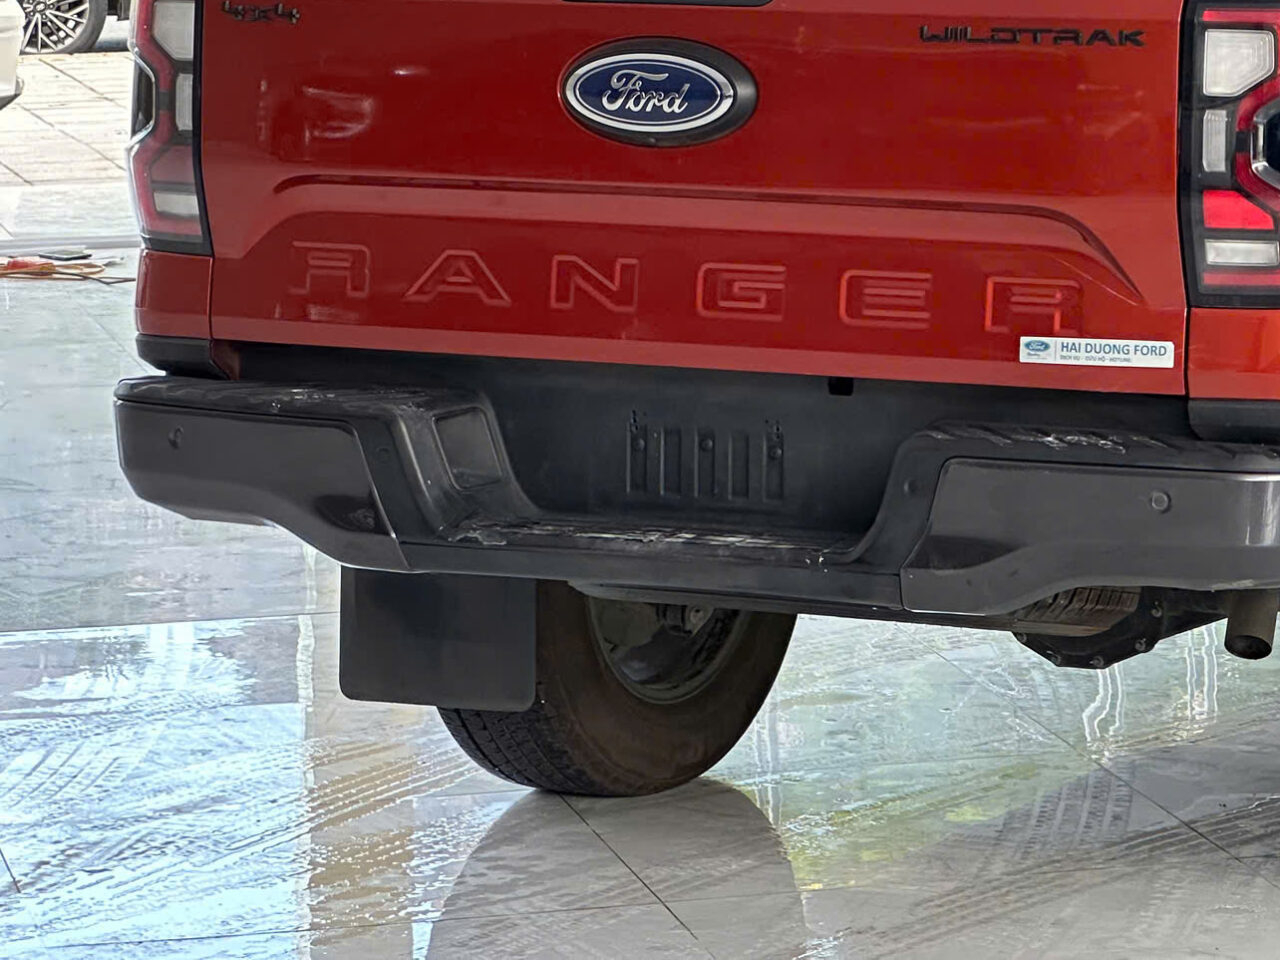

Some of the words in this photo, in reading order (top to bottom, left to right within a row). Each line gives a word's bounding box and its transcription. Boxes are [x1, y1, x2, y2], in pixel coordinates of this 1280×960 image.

[920, 24, 1146, 48] WILDTRAK
[601, 69, 692, 114] Ford
[290, 240, 1085, 336] RANGER
[1061, 342, 1082, 353] HAI
[1084, 343, 1131, 356] DUONG
[1134, 344, 1167, 357] FORD
